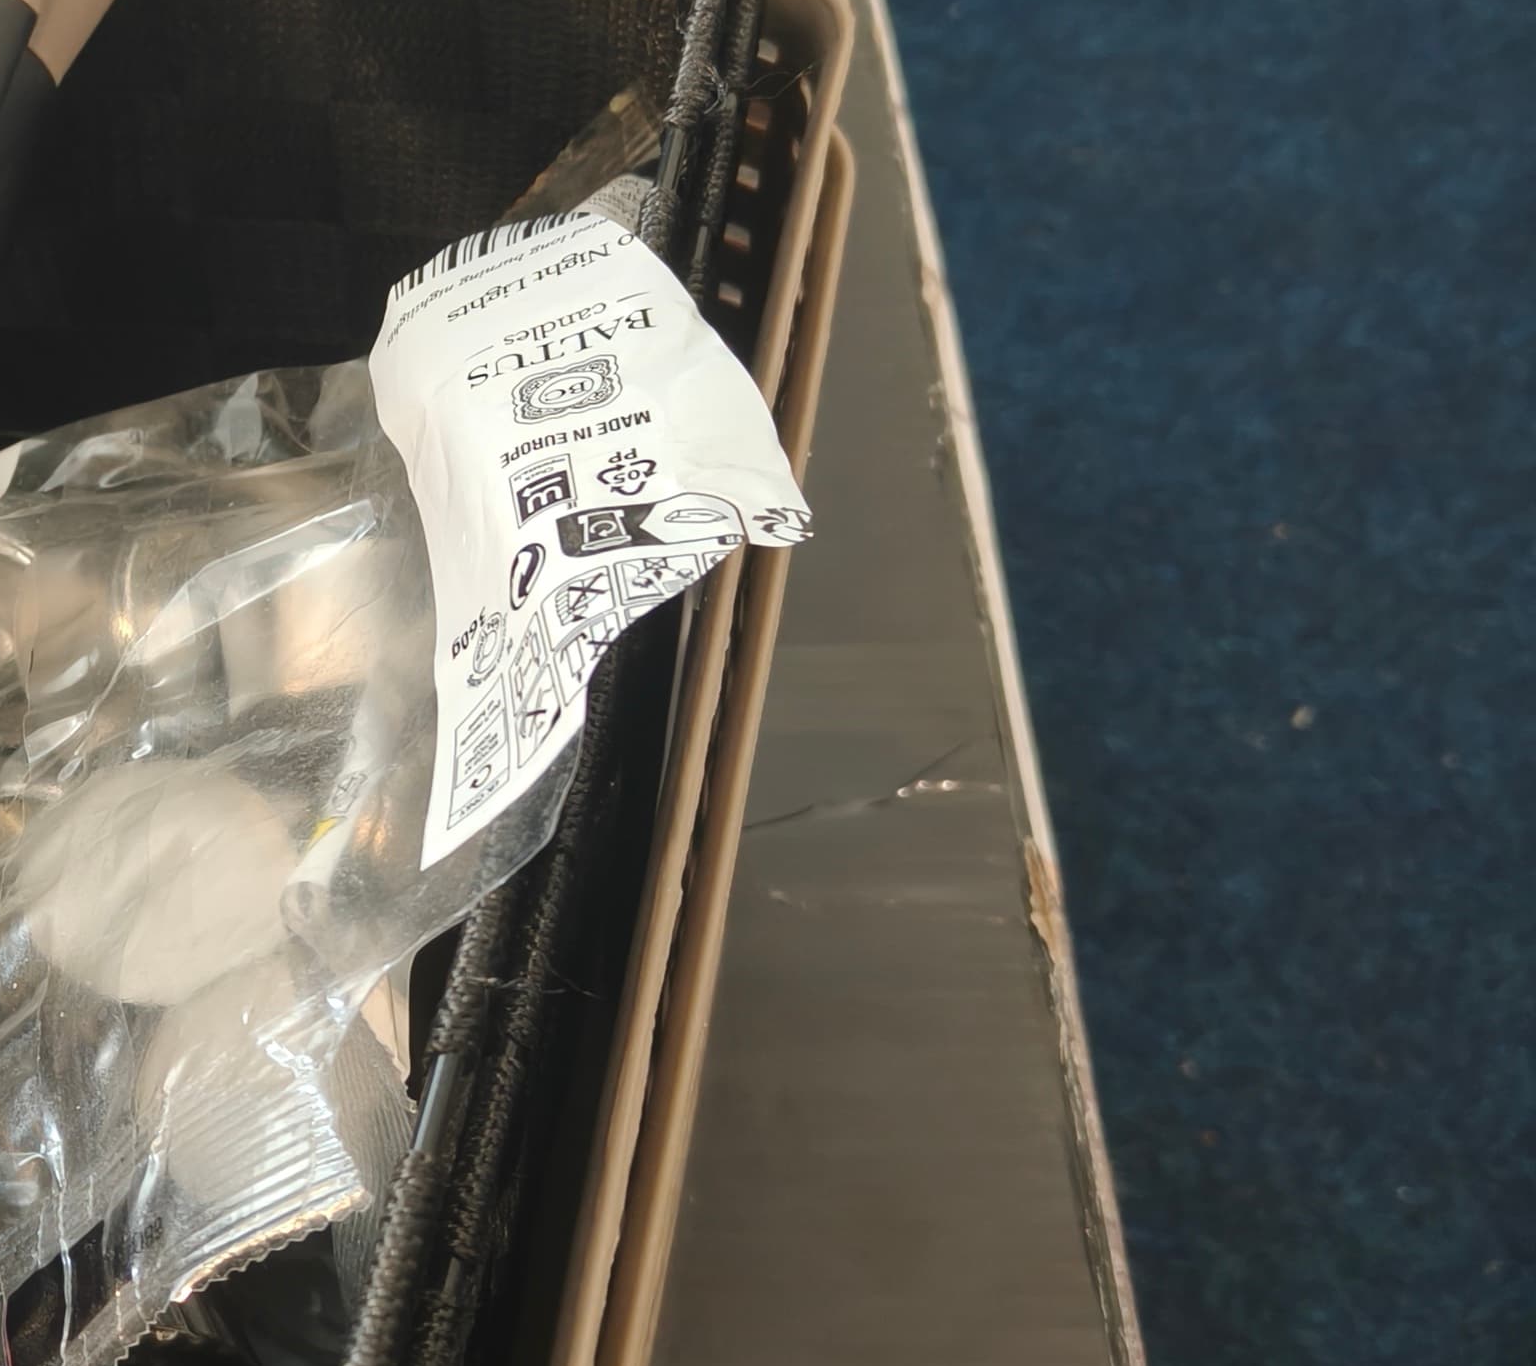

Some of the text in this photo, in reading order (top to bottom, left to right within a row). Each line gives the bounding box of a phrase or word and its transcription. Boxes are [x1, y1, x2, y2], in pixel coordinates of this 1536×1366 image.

[529, 233, 567, 254] long
[531, 241, 611, 282] Night
[459, 253, 525, 286] burning
[446, 276, 526, 323] Lights
[503, 302, 608, 347] candles
[466, 307, 656, 390] BALTUS
[543, 381, 587, 402] BC
[499, 410, 651, 468] MADE IN EUROPE
[608, 448, 637, 464] PP
[613, 469, 640, 484] 05
[452, 607, 486, 659] 360g
